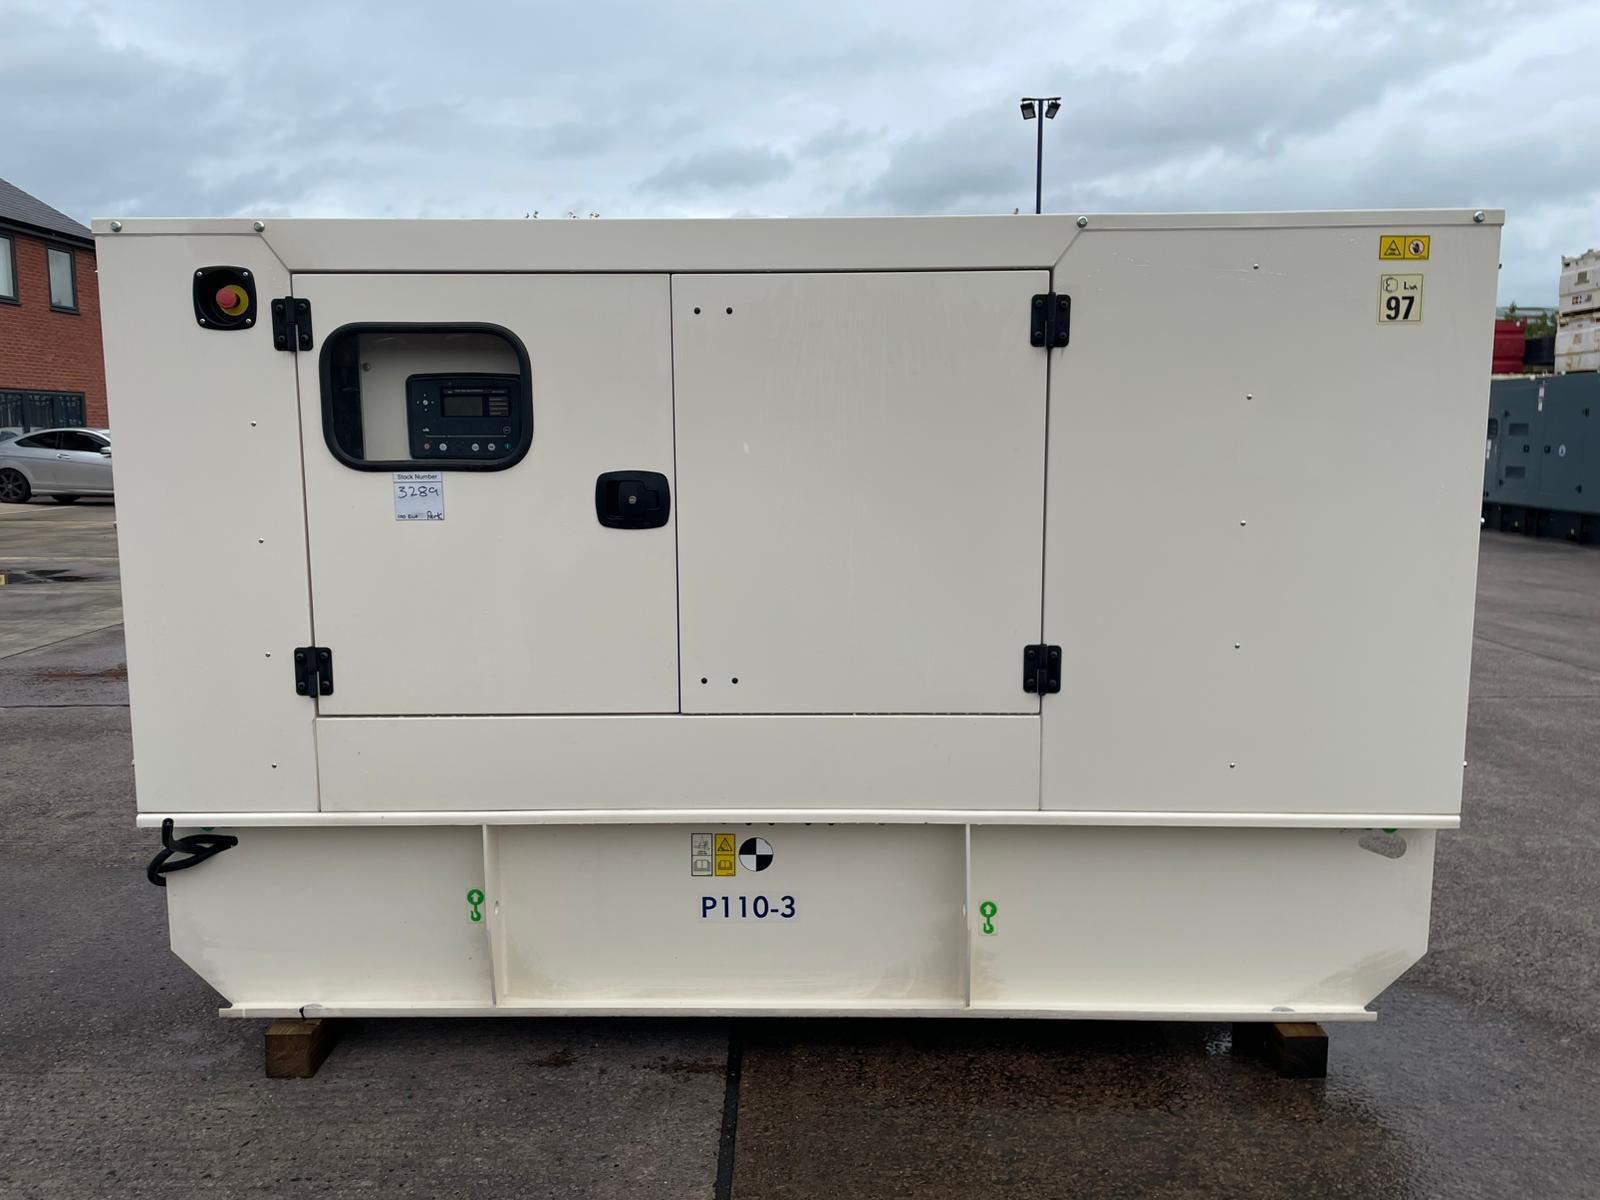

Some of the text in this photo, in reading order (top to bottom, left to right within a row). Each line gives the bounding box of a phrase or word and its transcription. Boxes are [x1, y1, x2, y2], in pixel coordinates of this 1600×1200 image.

[1386, 295, 1415, 320] 97
[397, 485, 439, 499] 3289
[702, 895, 796, 919] P110-3
